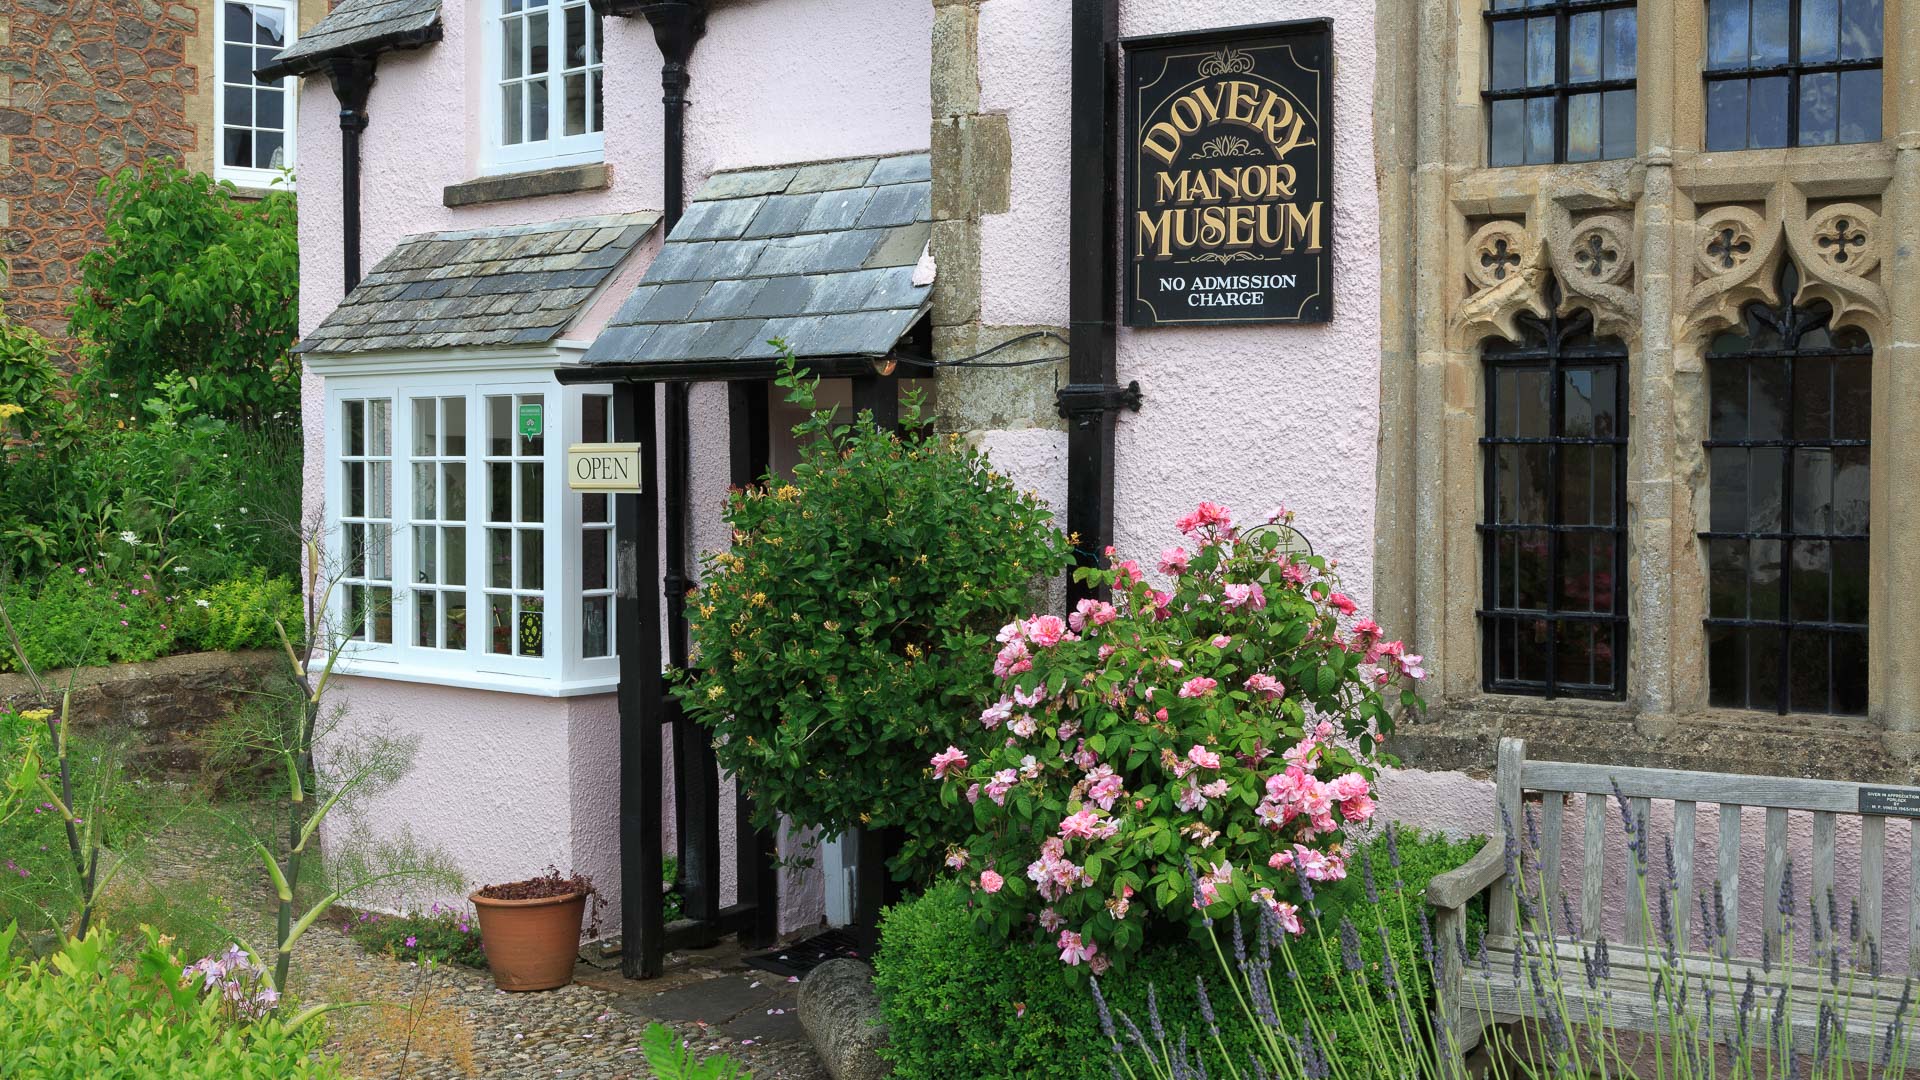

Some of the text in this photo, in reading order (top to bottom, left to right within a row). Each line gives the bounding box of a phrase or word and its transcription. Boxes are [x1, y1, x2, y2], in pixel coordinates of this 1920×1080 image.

[1142, 80, 1316, 165] DOVERY
[1156, 163, 1297, 203] MANOR
[1136, 201, 1323, 257] MUSEUM
[1159, 274, 1297, 292] NO ADMISSION
[1187, 291, 1264, 307] CHARGE
[576, 457, 628, 480] OPEN
